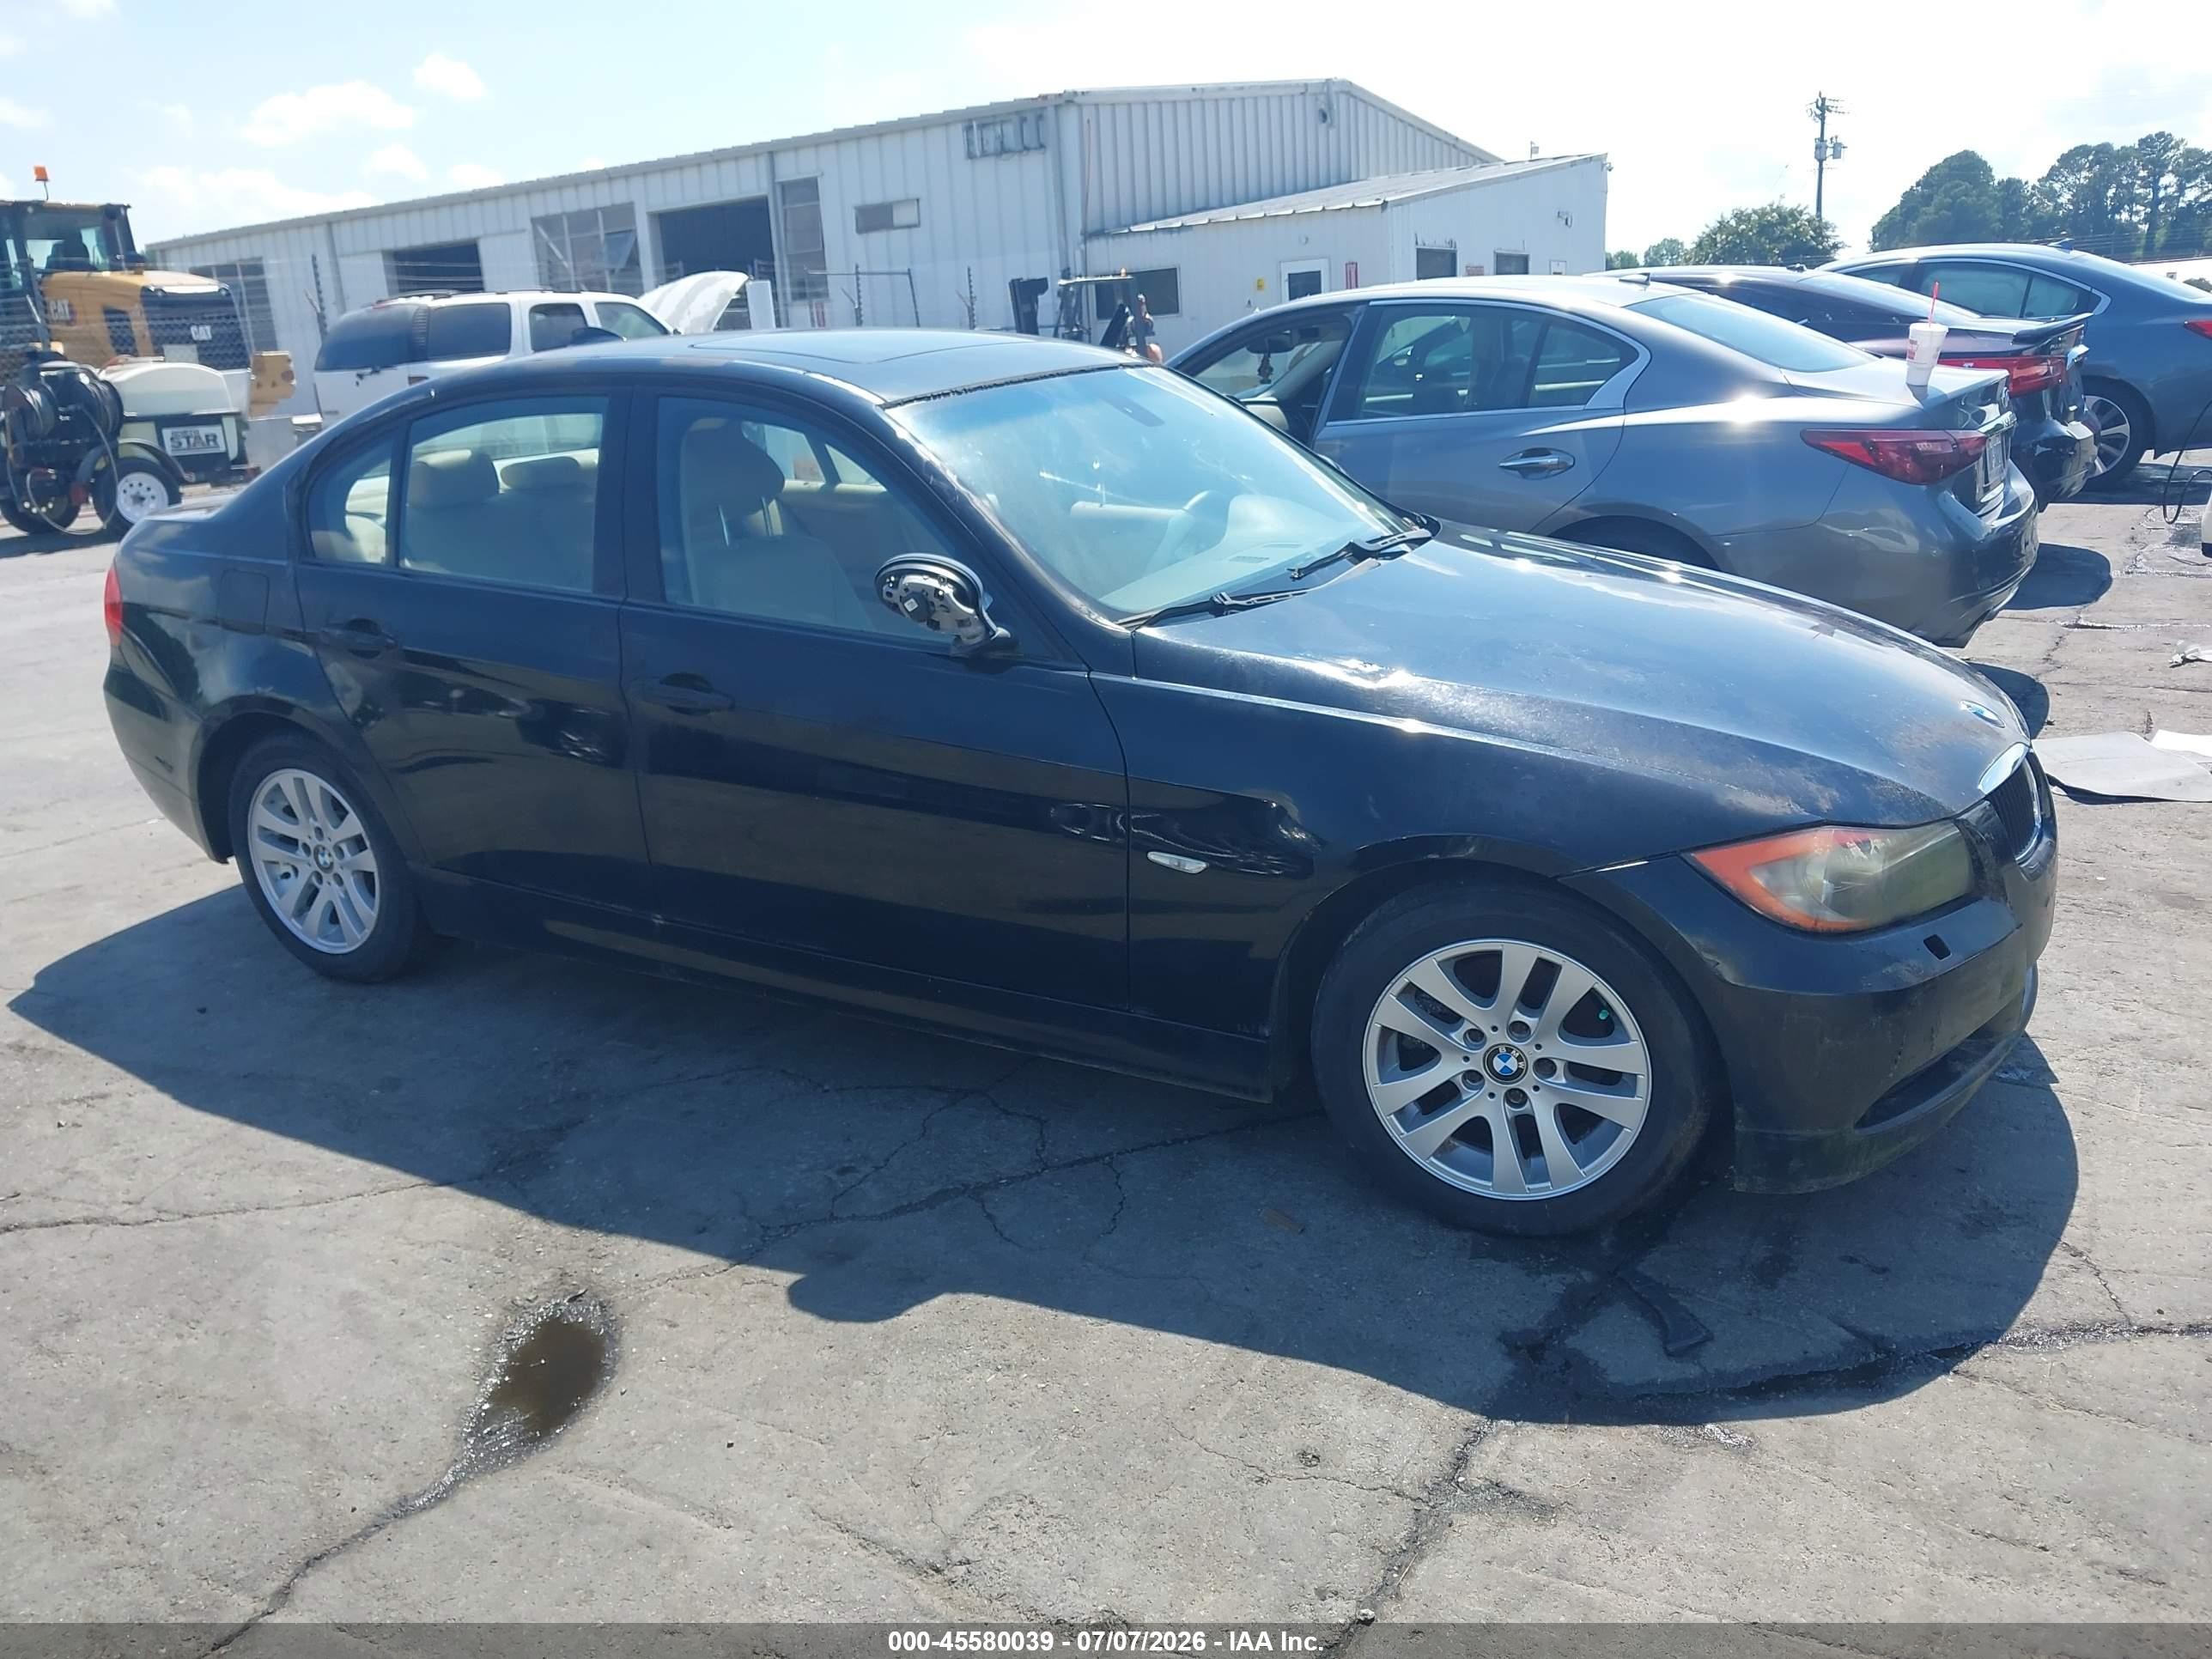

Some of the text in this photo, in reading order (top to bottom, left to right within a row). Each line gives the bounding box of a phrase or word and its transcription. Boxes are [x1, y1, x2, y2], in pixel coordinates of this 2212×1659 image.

[49, 299, 70, 320] CAT
[190, 325, 213, 341] CAT
[170, 433, 220, 448] STAR
